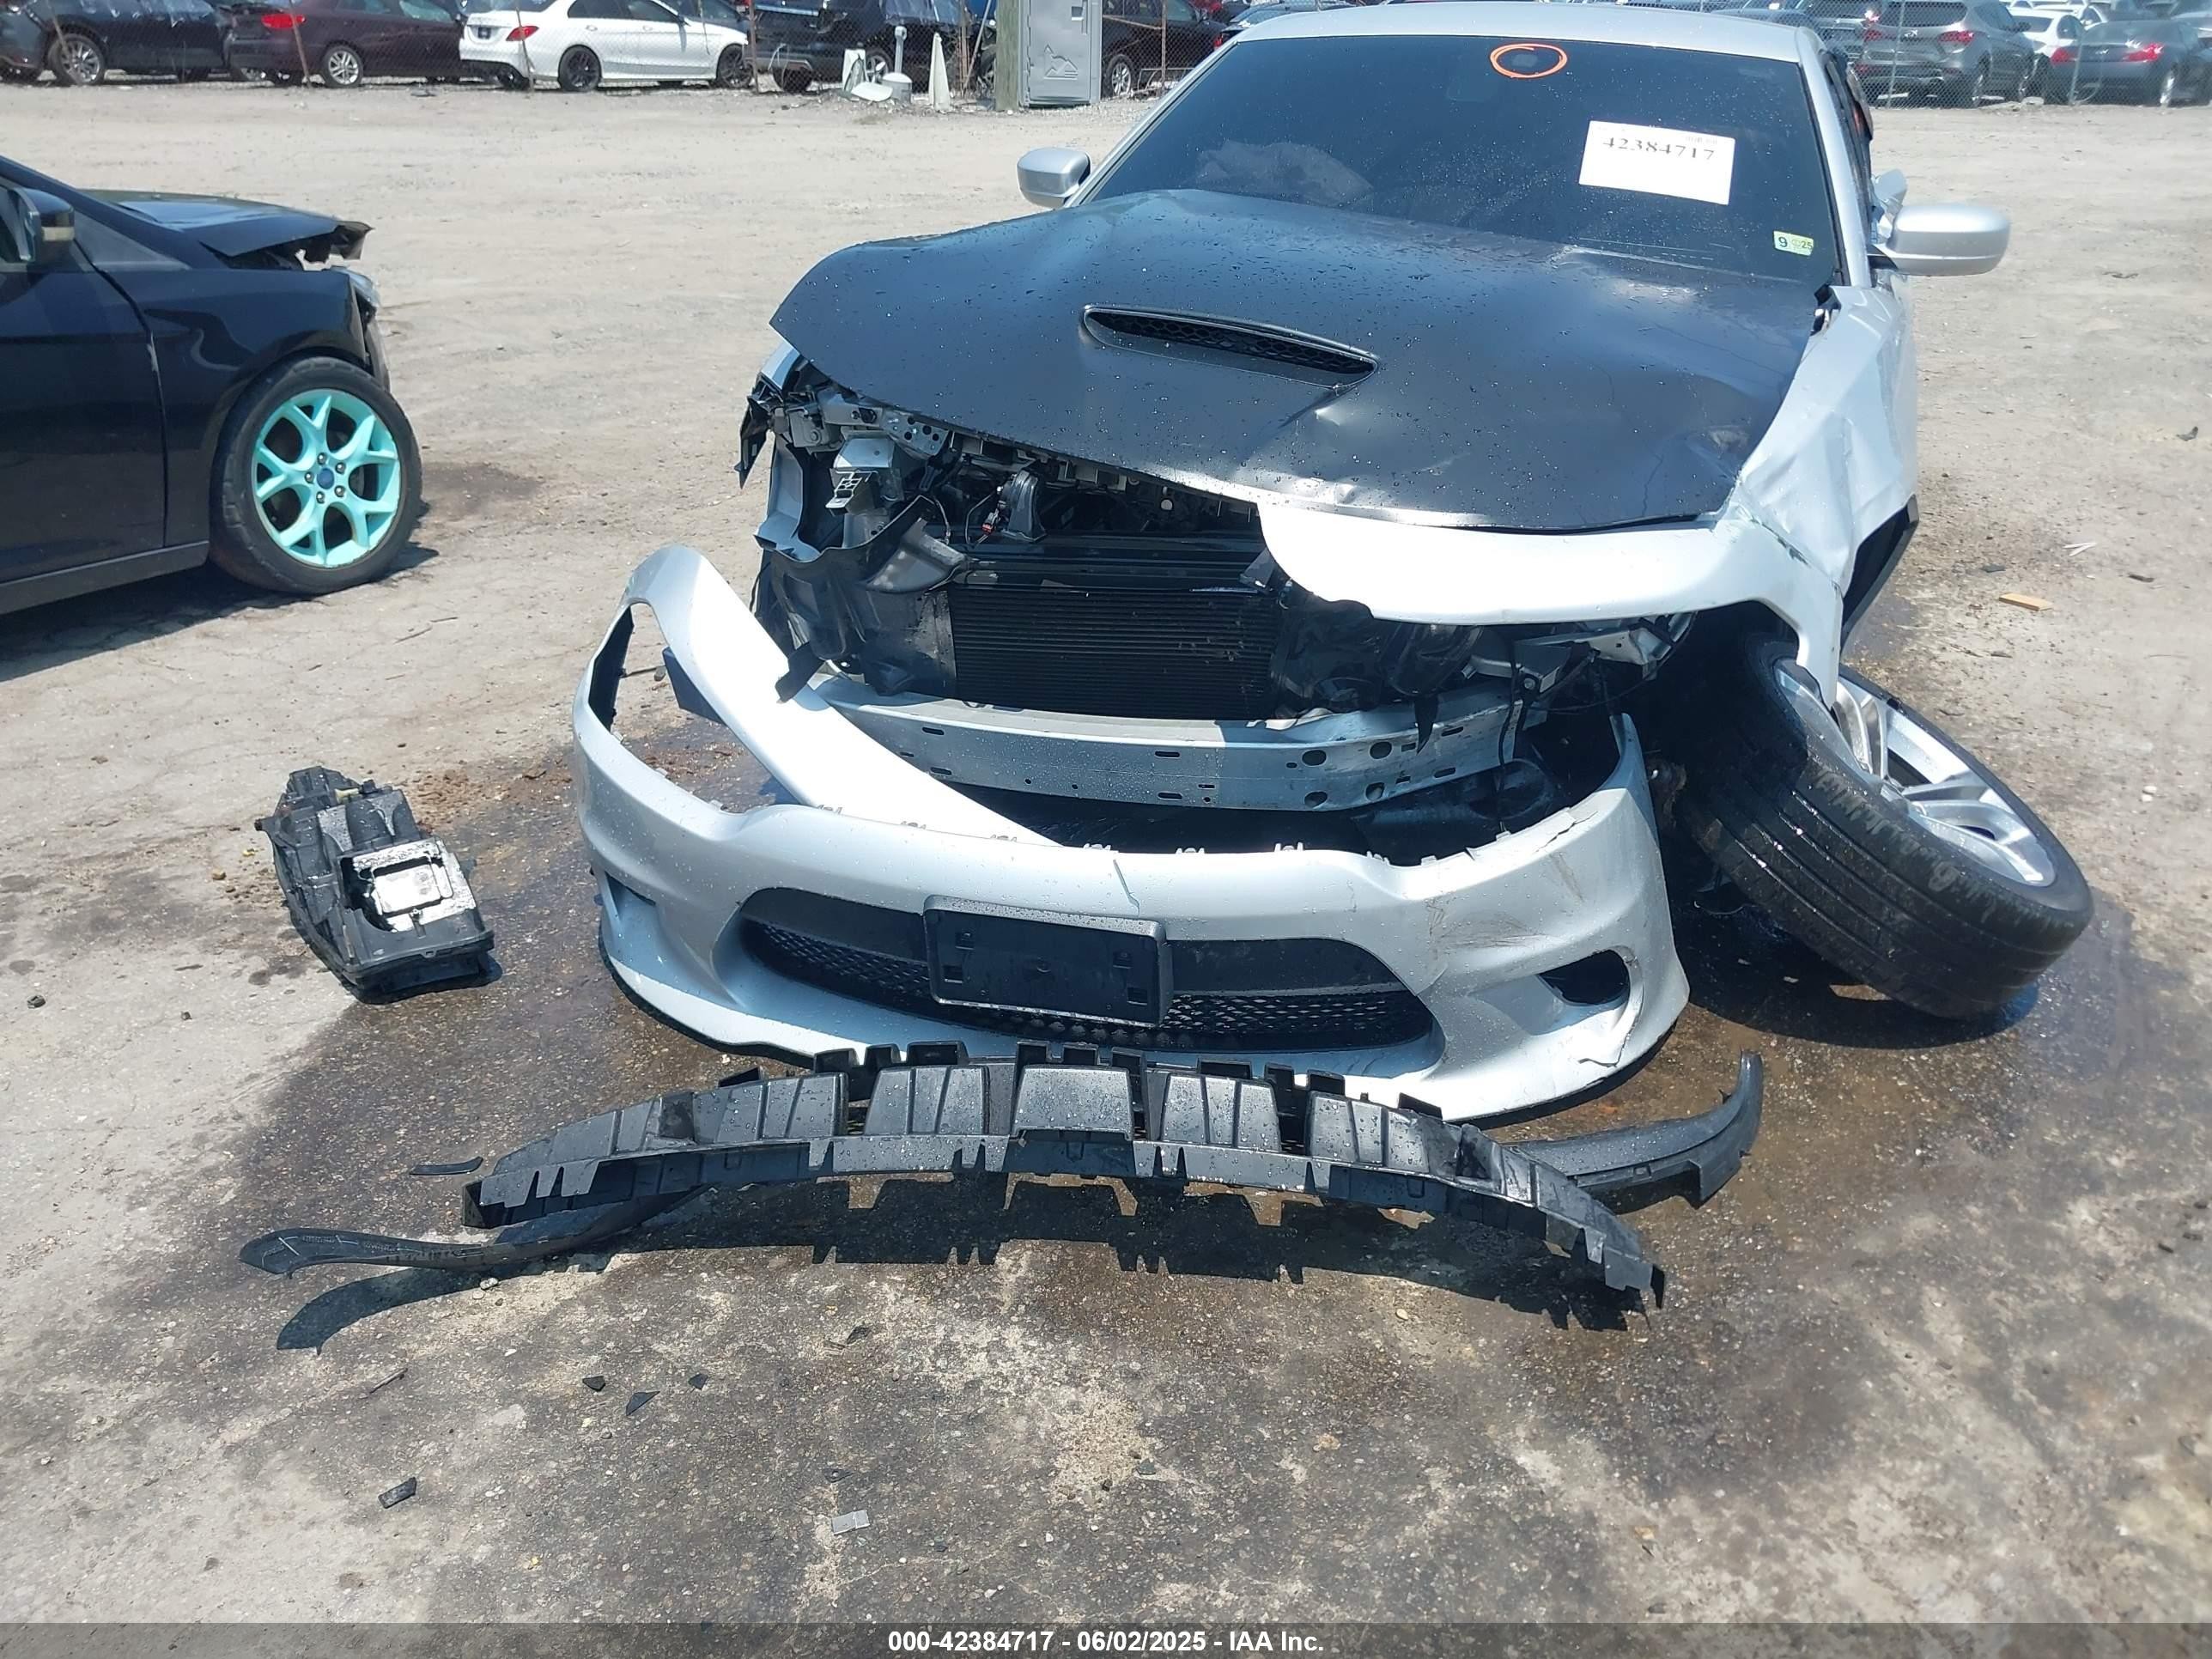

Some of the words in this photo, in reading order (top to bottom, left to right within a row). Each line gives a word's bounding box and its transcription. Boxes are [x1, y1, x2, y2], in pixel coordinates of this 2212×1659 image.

[1602, 137, 1716, 161] 42384717
[1778, 236, 1788, 248] 9
[1801, 240, 1813, 250] 25
